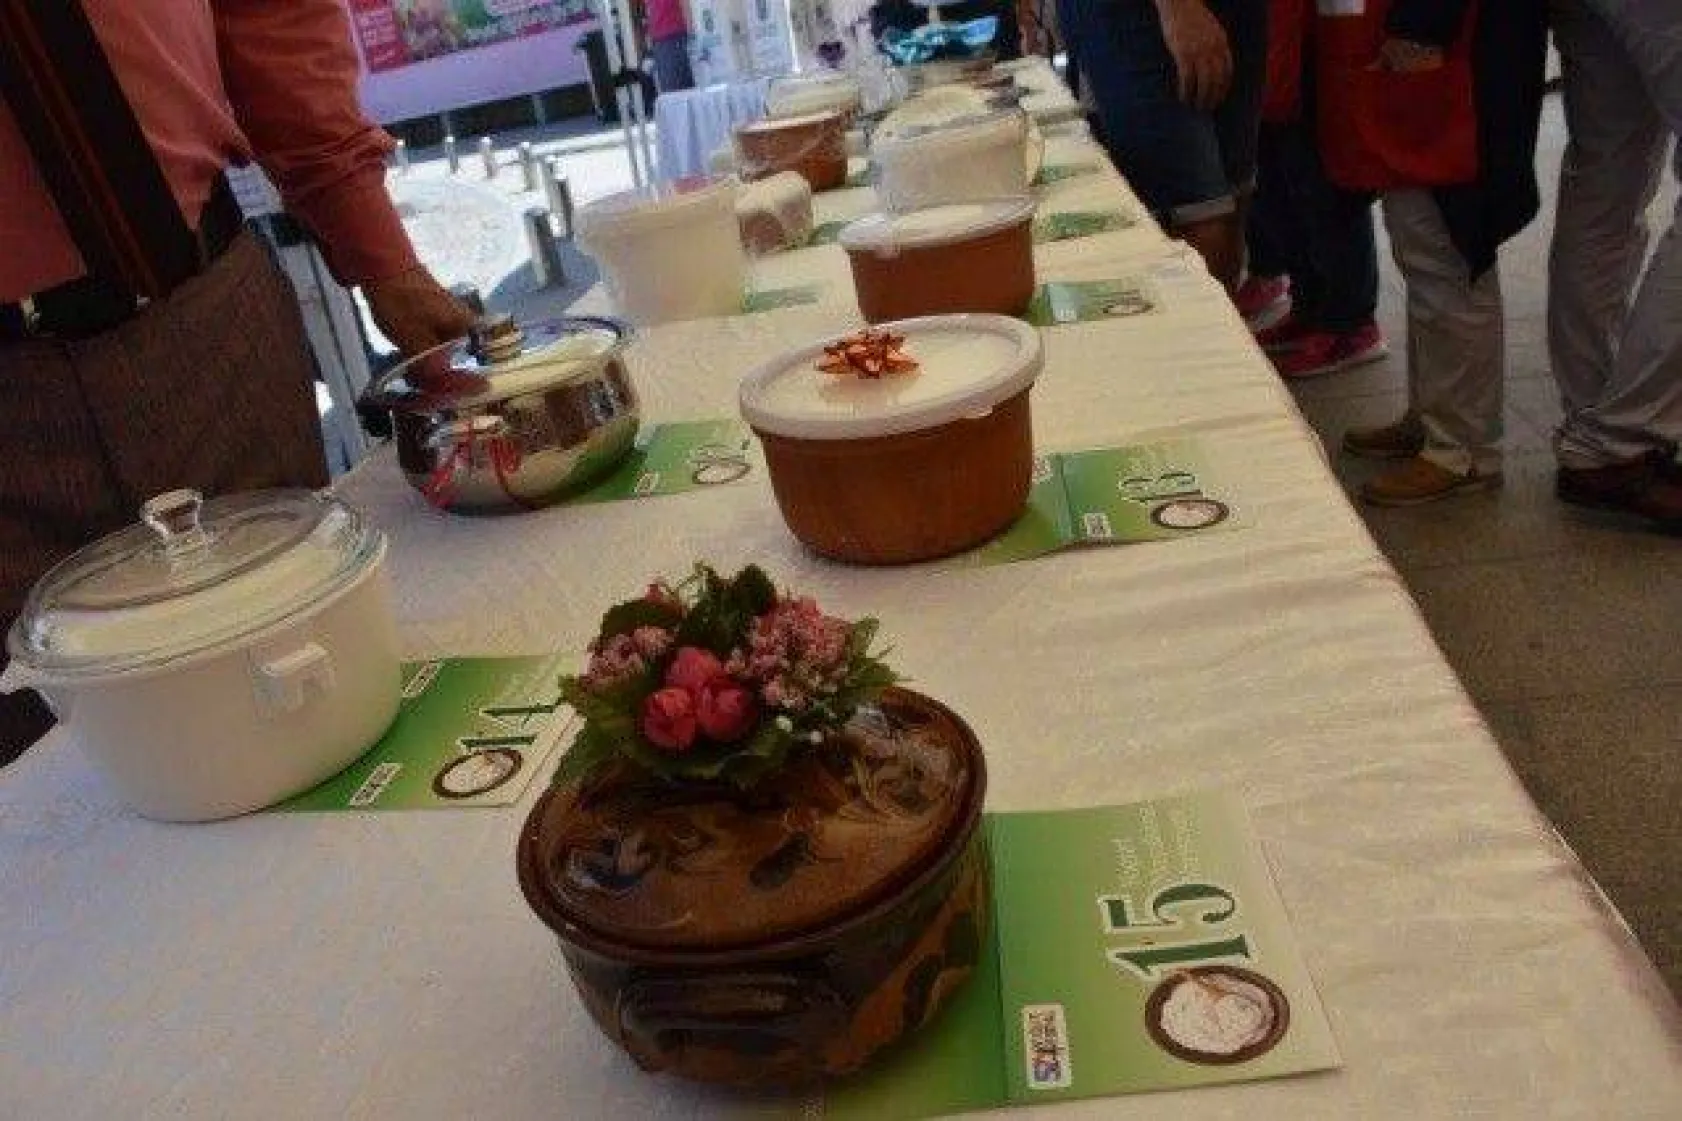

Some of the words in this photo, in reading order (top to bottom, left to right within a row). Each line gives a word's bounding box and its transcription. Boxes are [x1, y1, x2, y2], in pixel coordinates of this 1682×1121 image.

[1121, 474, 1203, 504] 13
[457, 700, 562, 755] 14
[1099, 883, 1252, 974] 15
